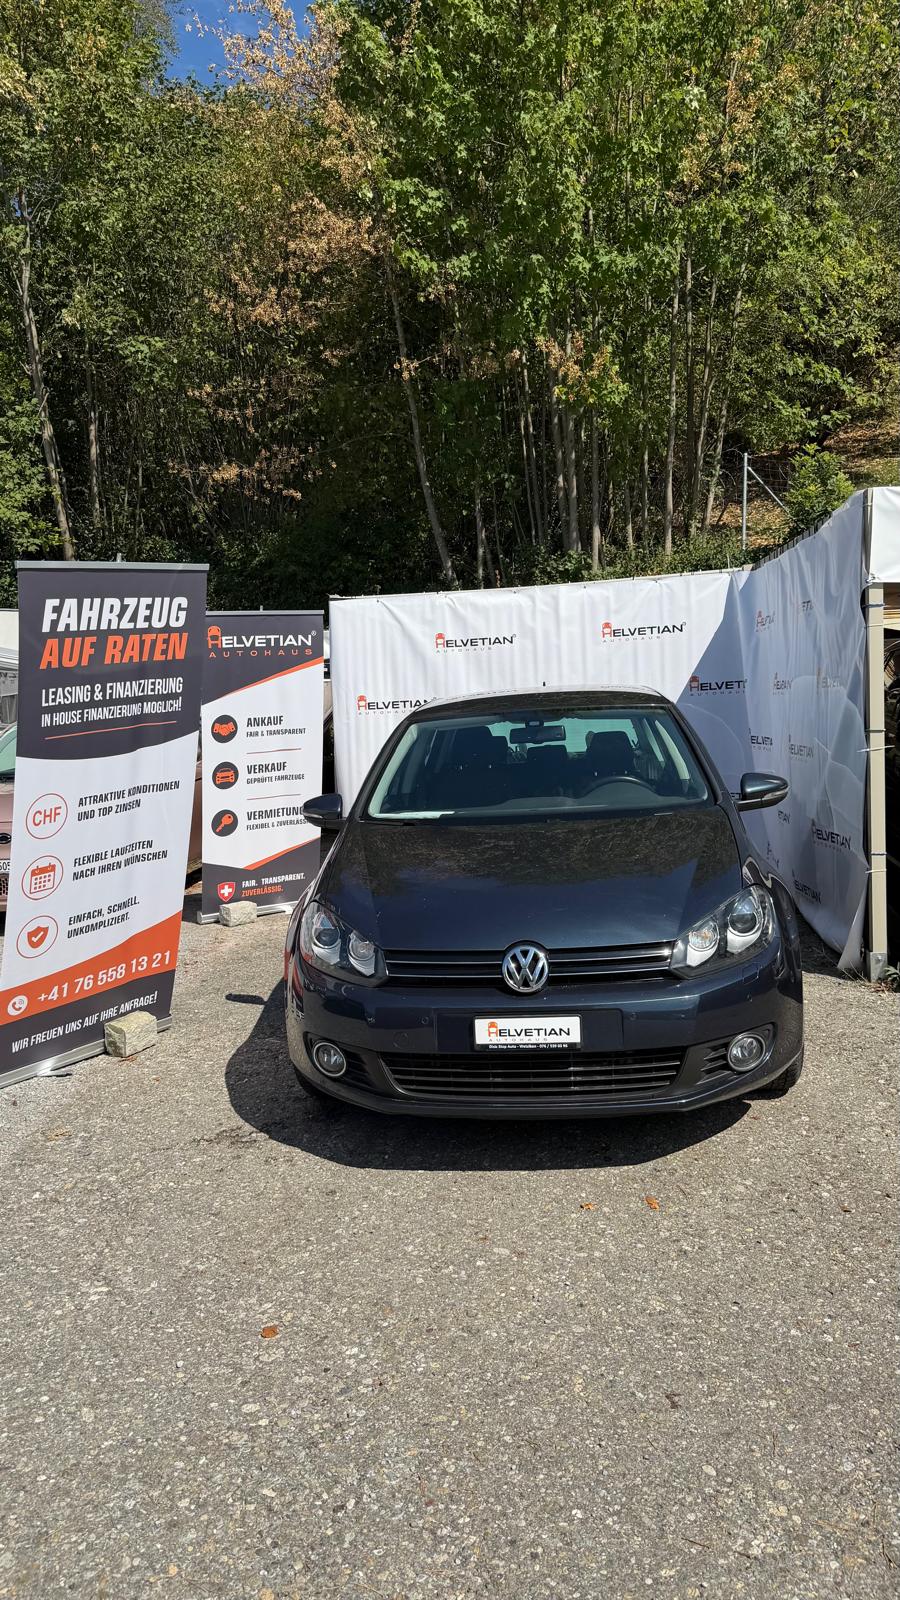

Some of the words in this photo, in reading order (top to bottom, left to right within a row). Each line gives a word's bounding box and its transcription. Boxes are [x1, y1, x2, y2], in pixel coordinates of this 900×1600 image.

[42, 596, 188, 632] FAHRZEUG
[39, 636, 98, 669] AUF
[104, 632, 188, 665] RATEN
[208, 648, 313, 658] AUTOHAUS
[42, 685, 91, 707] LEASING
[94, 683, 103, 700] &
[106, 677, 183, 700] FINANZIERUNG
[689, 676, 746, 692] HELVETI
[41, 714, 51, 727] IN
[53, 710, 82, 726] HOUSE
[84, 703, 141, 722] FINANZIERUNG
[246, 715, 284, 728] ANKAUF
[246, 730, 259, 738] FAIR
[266, 728, 306, 737] TRANSPARENT
[246, 761, 287, 775] VERKAUF
[246, 775, 273, 785] GEPRÜFTE
[274, 773, 305, 782] FAHRZEUGE
[78, 790, 126, 808] ATTRAKTIVE
[127, 780, 180, 799] KONDITIONEN
[32, 806, 62, 827] CHF
[77, 811, 95, 822] UND
[97, 806, 113, 818] TOP
[114, 799, 141, 814] ZINSEN
[246, 823, 270, 831] FLEXIBEL
[73, 849, 108, 868] FLEXIBLE
[110, 840, 153, 859] LAUFZEITEN
[72, 868, 95, 882] NACH
[98, 862, 122, 875] IHREN
[124, 850, 168, 869] WÜNSCHEN
[241, 884, 284, 898] ZUVERLÄSSIG.
[242, 879, 258, 888] FAIR.
[261, 872, 306, 885] TRANSPARENT.
[68, 909, 105, 926] EINFACH,
[107, 896, 140, 915] SCHNELL.
[67, 912, 130, 939] UNKOMPLIZIERT.
[37, 984, 68, 1002] +41
[75, 975, 94, 994] 76
[97, 964, 125, 986] 558
[131, 956, 148, 973] 13
[152, 950, 171, 968] 21
[11, 1037, 29, 1053] WIR
[30, 1025, 64, 1046] FREUEN
[65, 1019, 82, 1035] UNS
[83, 1013, 100, 1029] AUF
[100, 1007, 118, 1023] IHRE
[119, 991, 158, 1014] ANFRAGE!
[487, 1021, 571, 1038] HELVETIAN
